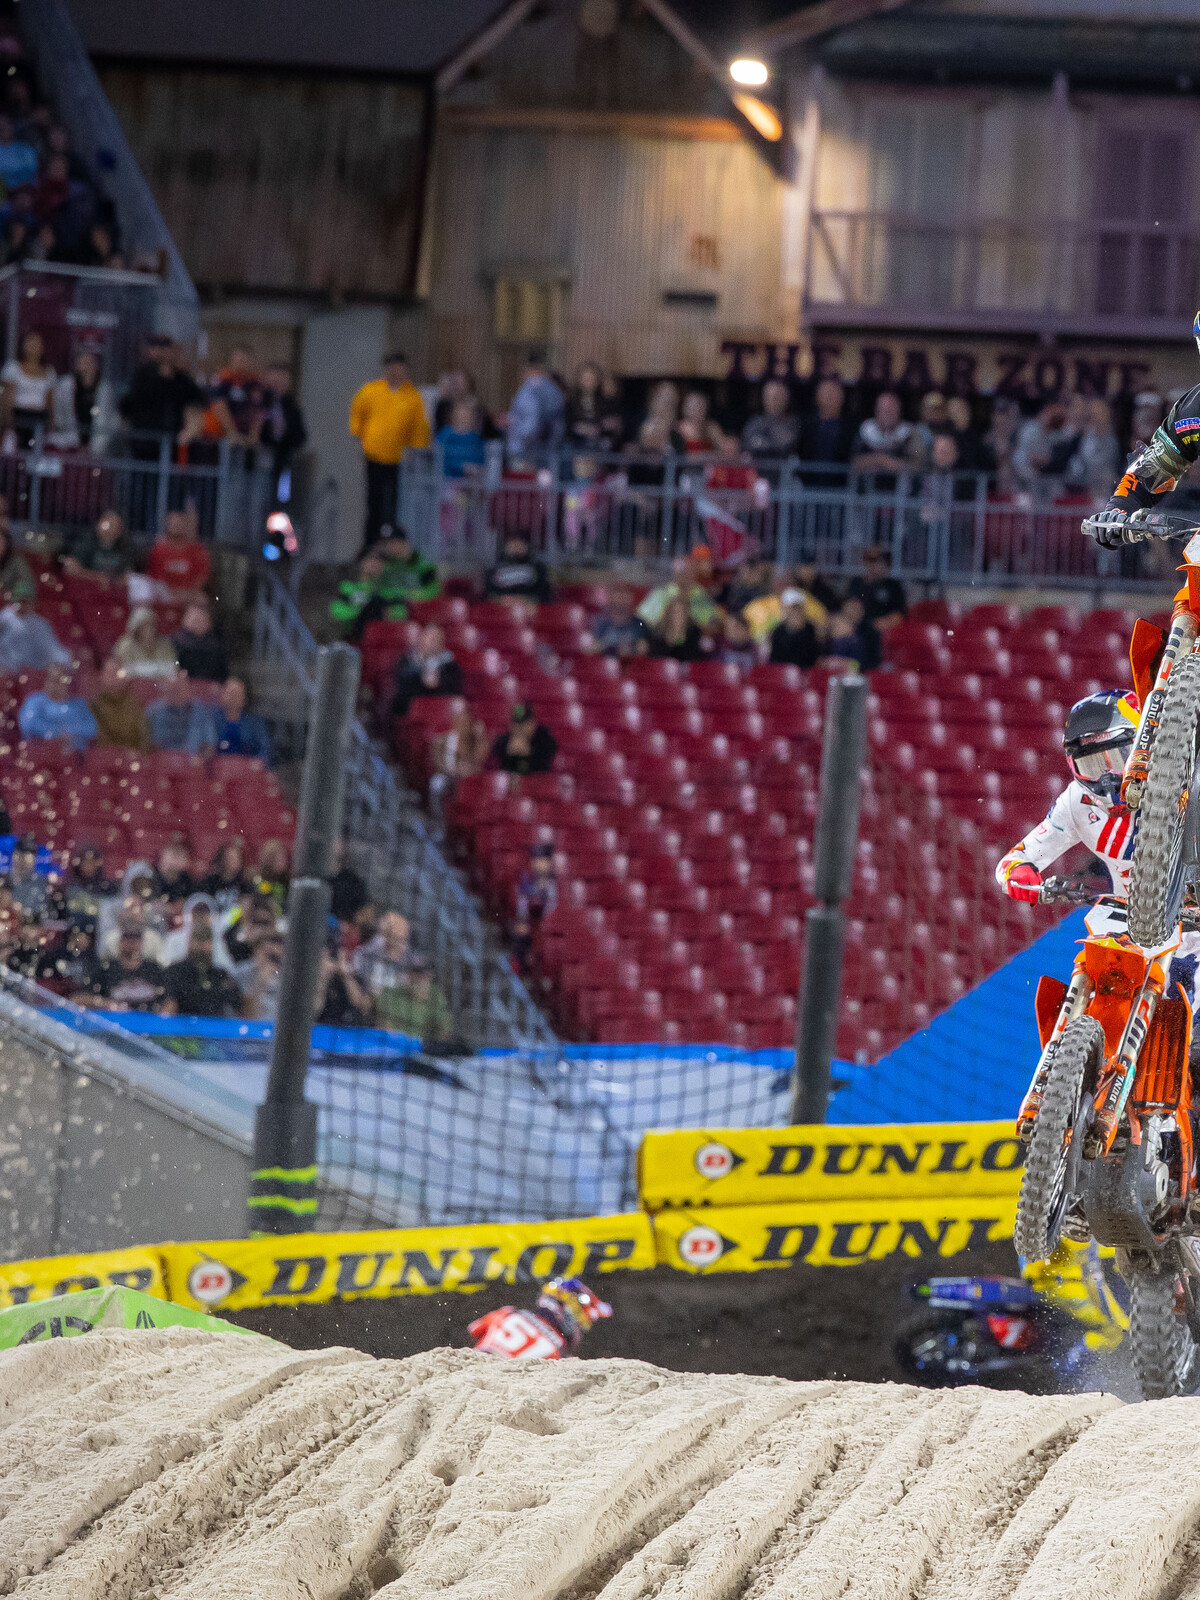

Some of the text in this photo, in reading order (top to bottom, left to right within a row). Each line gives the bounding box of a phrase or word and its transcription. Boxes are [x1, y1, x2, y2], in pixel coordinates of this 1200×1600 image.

[720, 341, 845, 381] THE
[1110, 1060, 1128, 1105] DUNLP
[757, 1138, 1028, 1177] DUNLO
[260, 1239, 637, 1297] DUNLOP
